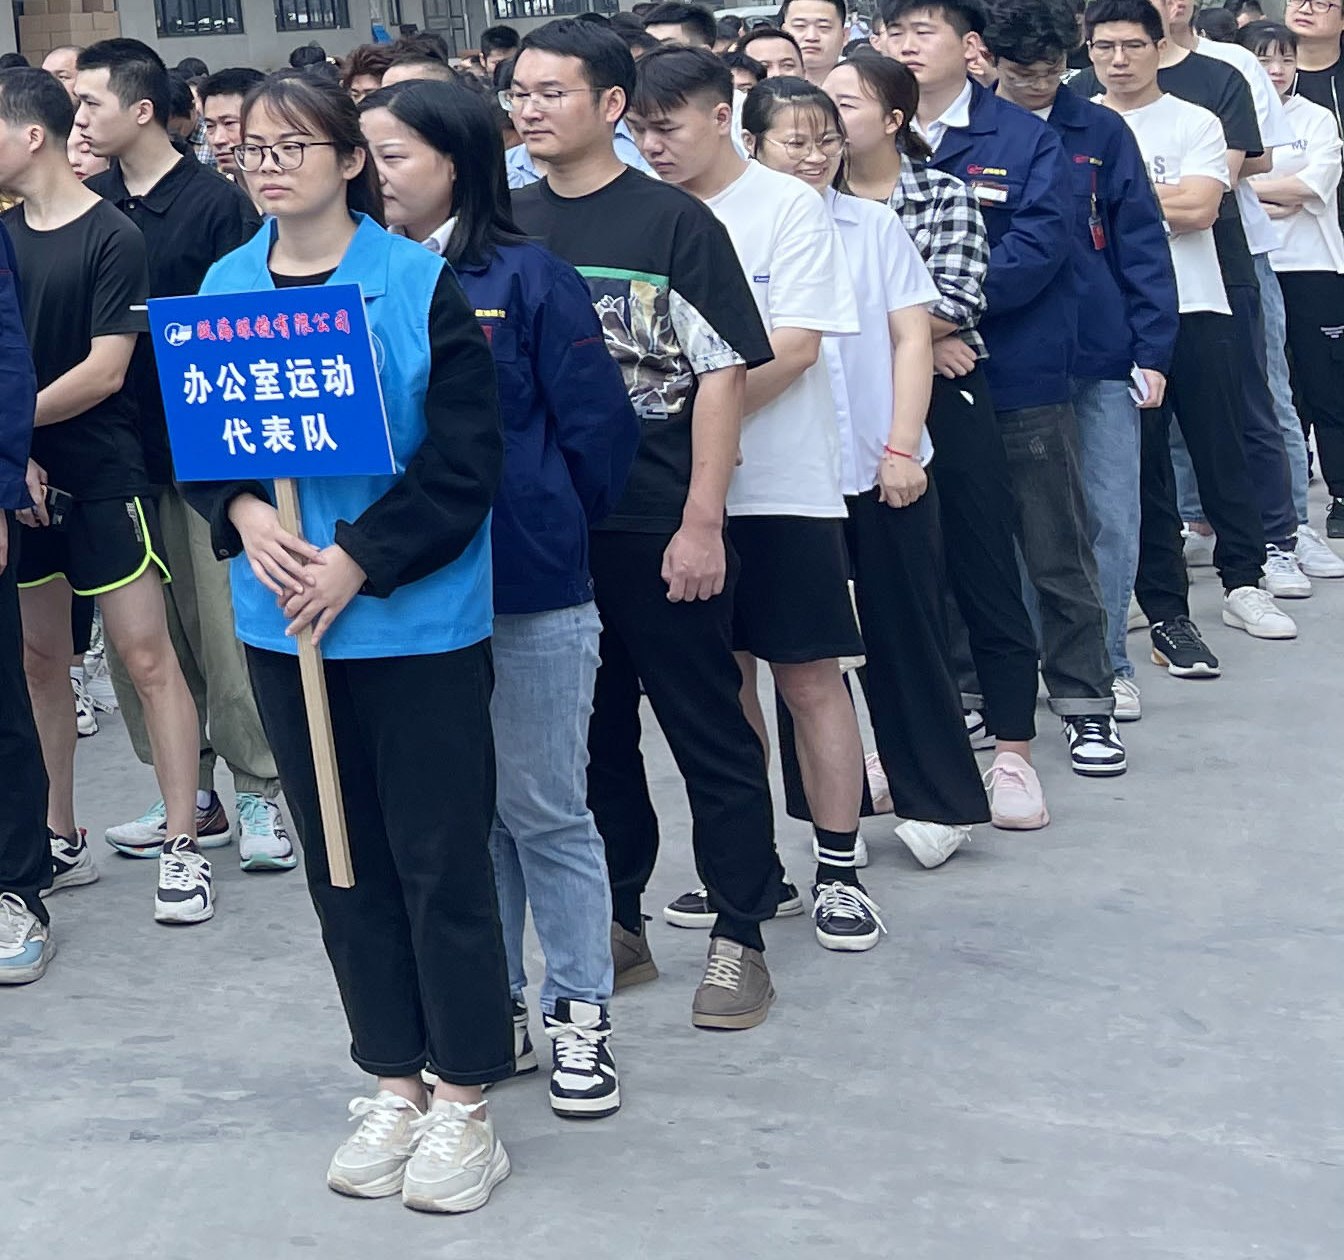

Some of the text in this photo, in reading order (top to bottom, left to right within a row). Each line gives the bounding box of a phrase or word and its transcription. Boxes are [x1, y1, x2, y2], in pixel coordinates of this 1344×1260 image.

[183, 354, 355, 405] 办公室运动
[222, 413, 339, 455] 代表队
